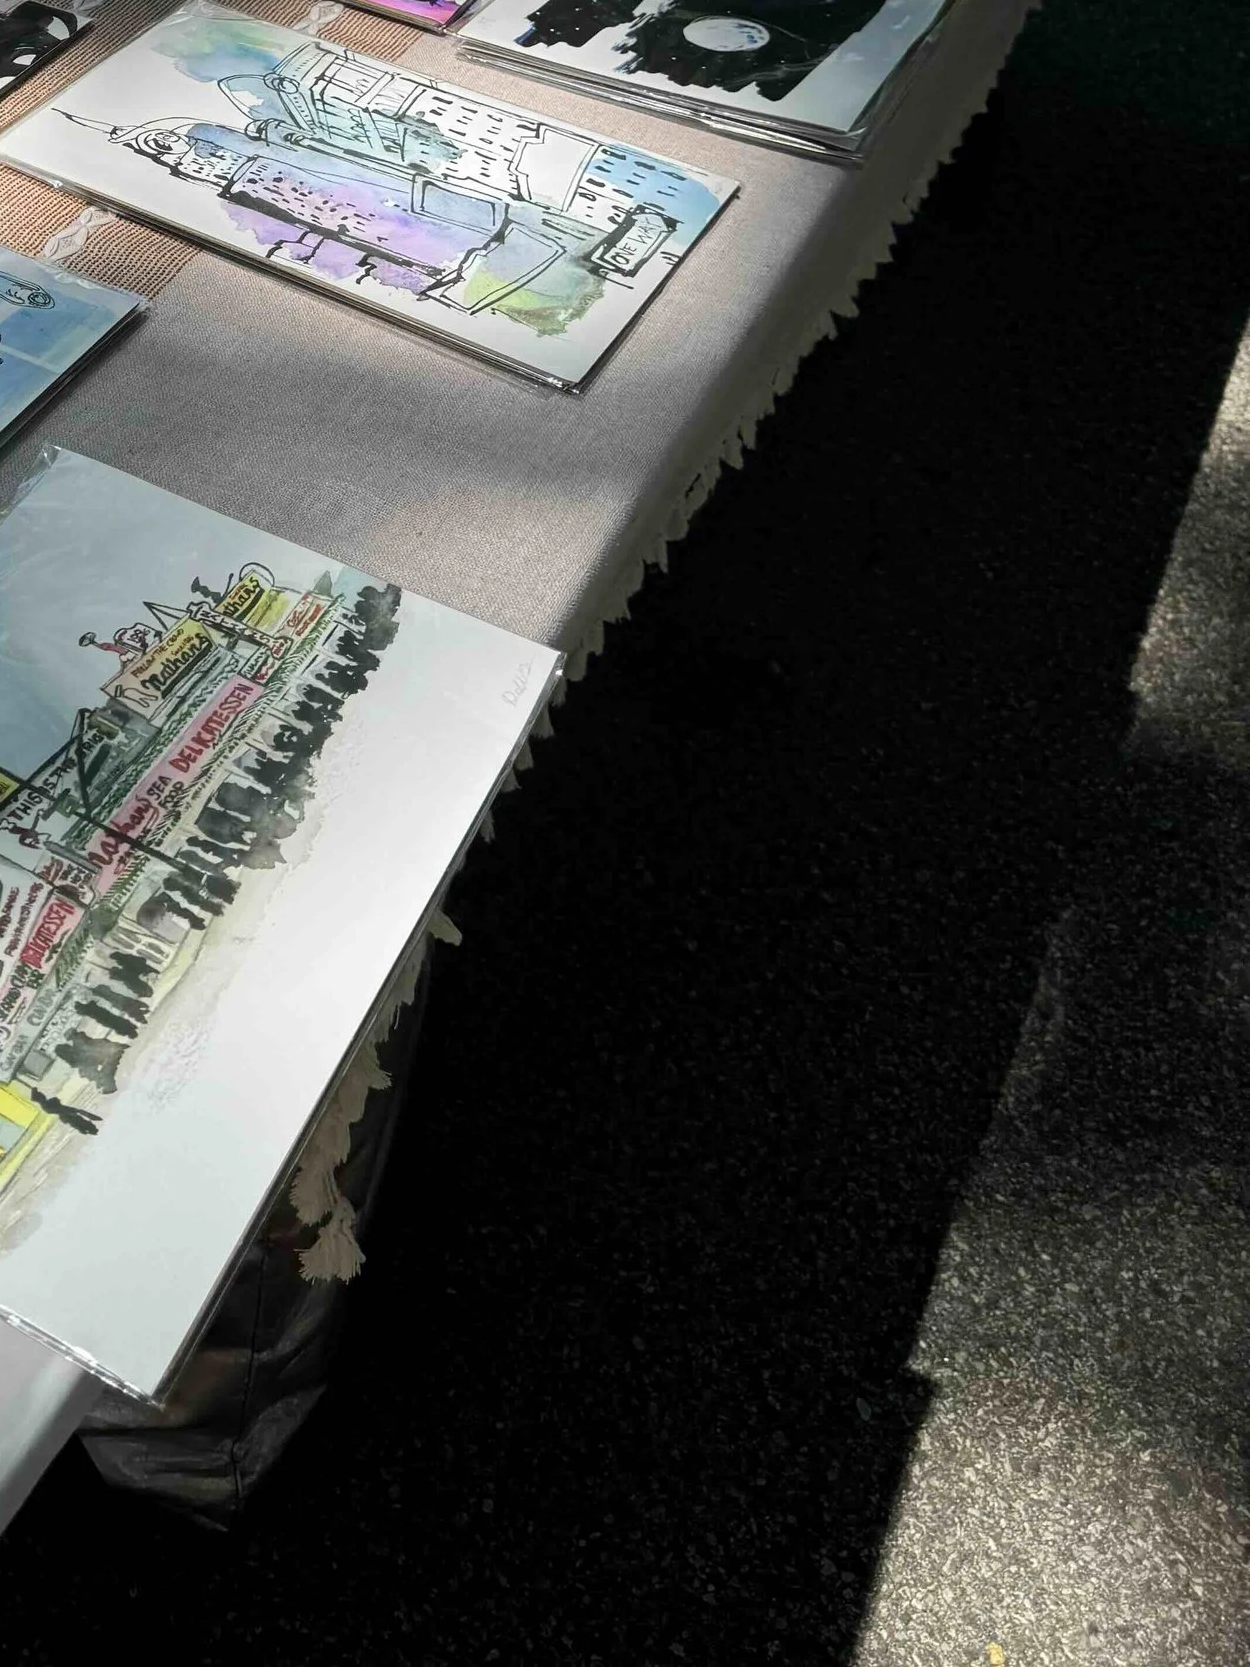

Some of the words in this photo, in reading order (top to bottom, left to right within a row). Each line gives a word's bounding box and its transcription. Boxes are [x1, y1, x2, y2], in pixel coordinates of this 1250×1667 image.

[611, 243, 637, 265] ONE
[627, 217, 661, 244] WAY
[147, 775, 171, 802] SEA
[169, 684, 253, 774] DELICATESSEN
[159, 780, 185, 811] FOOD
